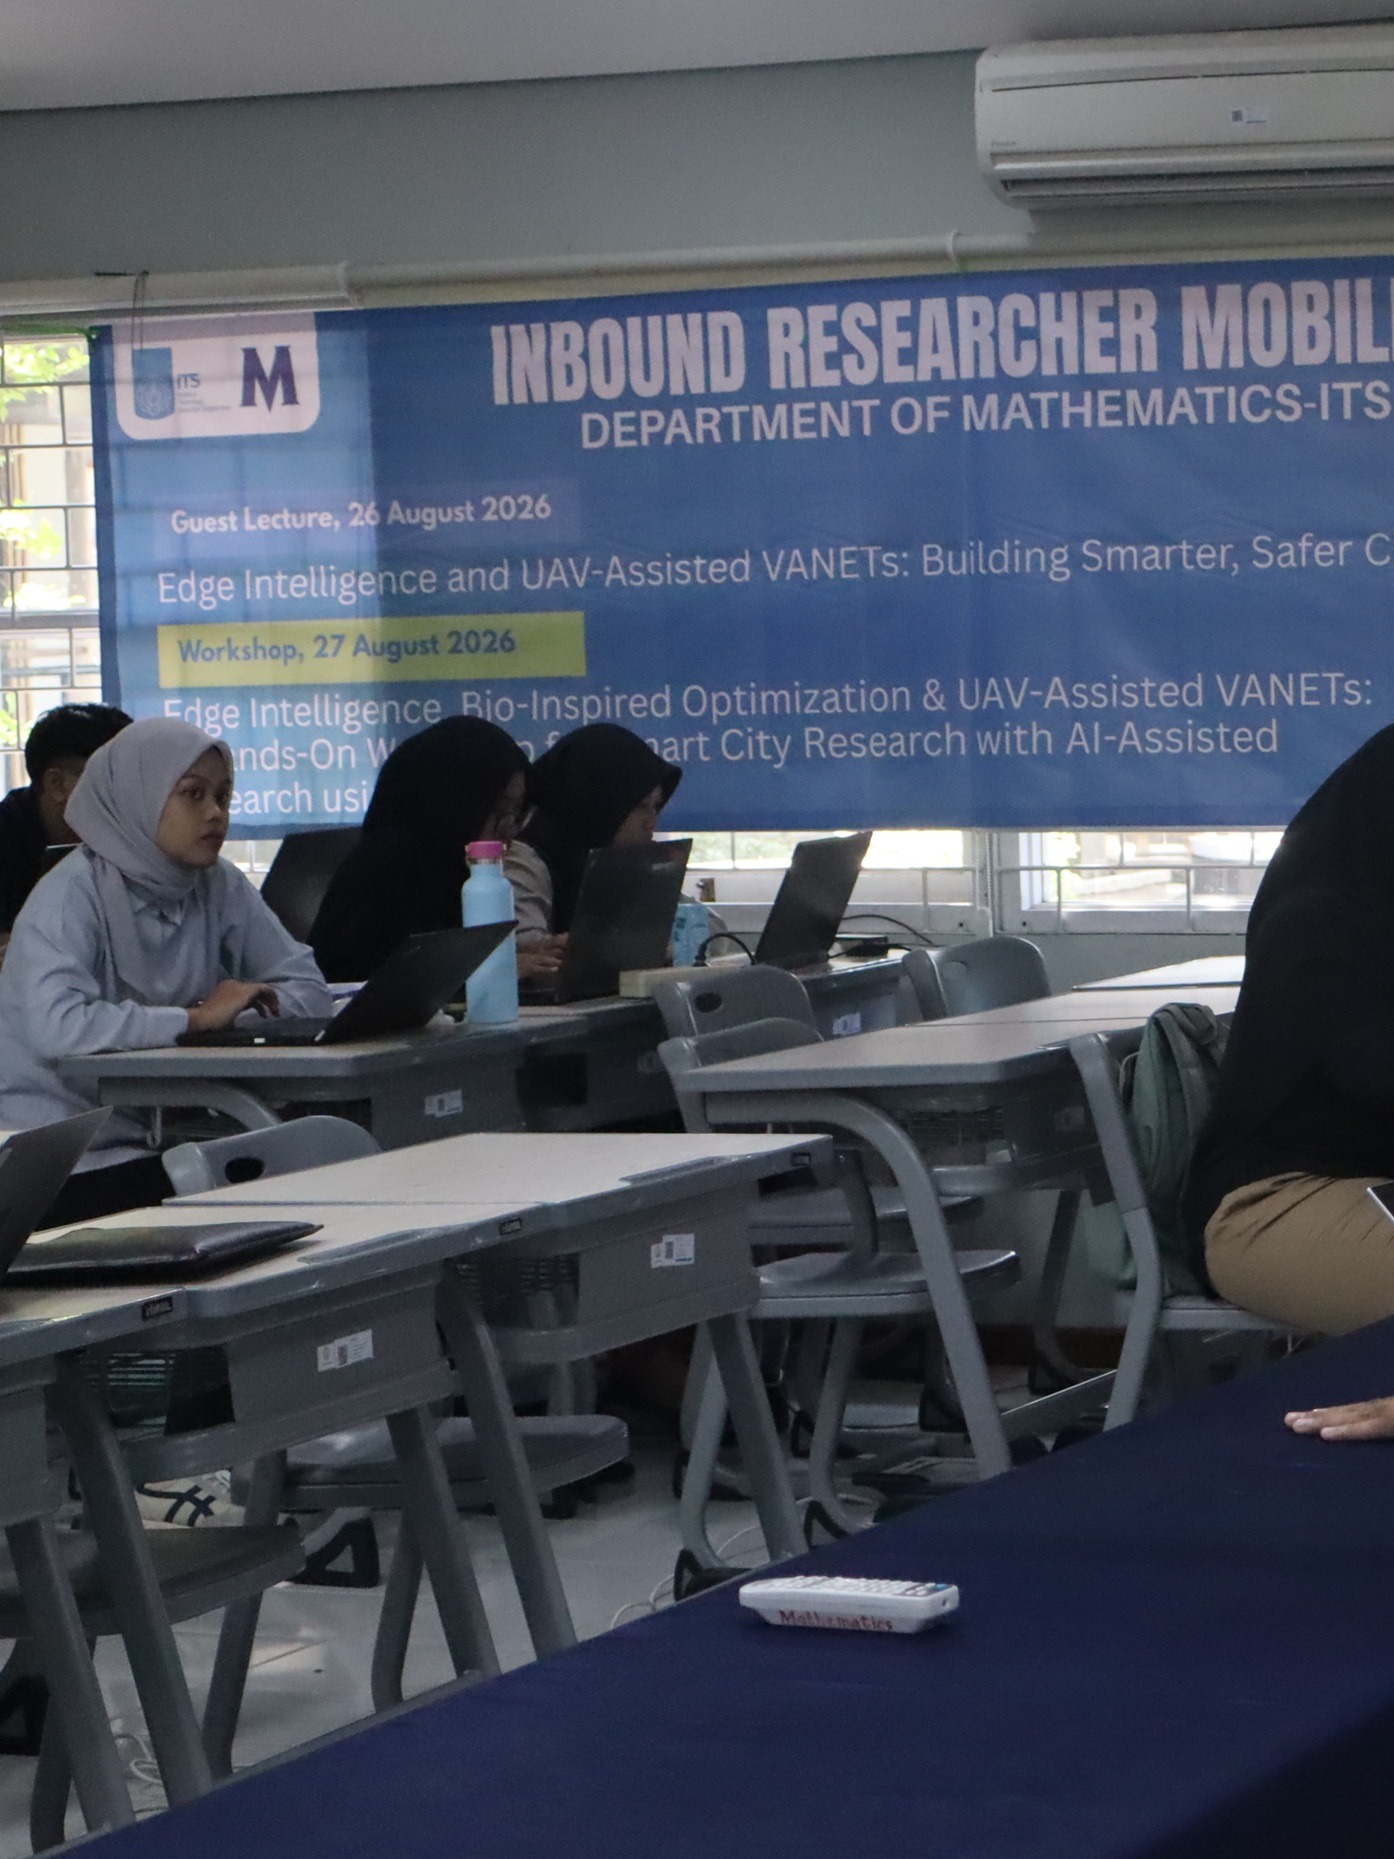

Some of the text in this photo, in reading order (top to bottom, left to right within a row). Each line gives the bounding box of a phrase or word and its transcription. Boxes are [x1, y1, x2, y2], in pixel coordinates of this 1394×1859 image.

[240, 345, 300, 412] M
[490, 310, 745, 405] INBOUND
[767, 289, 1159, 389] RESEARCHER
[581, 379, 1392, 449] DEPARTMENT OF MATHEMATICS-ITS
[171, 494, 552, 534] Guest Lecture, 26 August 2026
[157, 569, 235, 610] Edge
[245, 563, 437, 605] Intelligence
[447, 558, 509, 593] and
[522, 550, 751, 589] UAV-Assisted
[762, 546, 910, 581] VANETs:
[922, 535, 1071, 582] Building
[1081, 537, 1240, 577] Smarter,
[1251, 532, 1354, 569] Safer
[177, 628, 517, 667] Workshop, 27 August 2026
[164, 697, 240, 737] Edge
[462, 684, 671, 726] Bio-Inspired
[683, 679, 912, 725] Optimization
[922, 678, 946, 712] &
[959, 672, 1203, 710] UAV-Assisted
[1215, 672, 1373, 708] VANETs:
[234, 738, 356, 771] nds-On
[645, 732, 711, 763] art
[721, 727, 792, 768] City
[804, 722, 966, 759] Research
[976, 721, 1053, 756] with
[1066, 718, 1279, 755] AI-Assisted
[228, 780, 368, 814] earch usi
